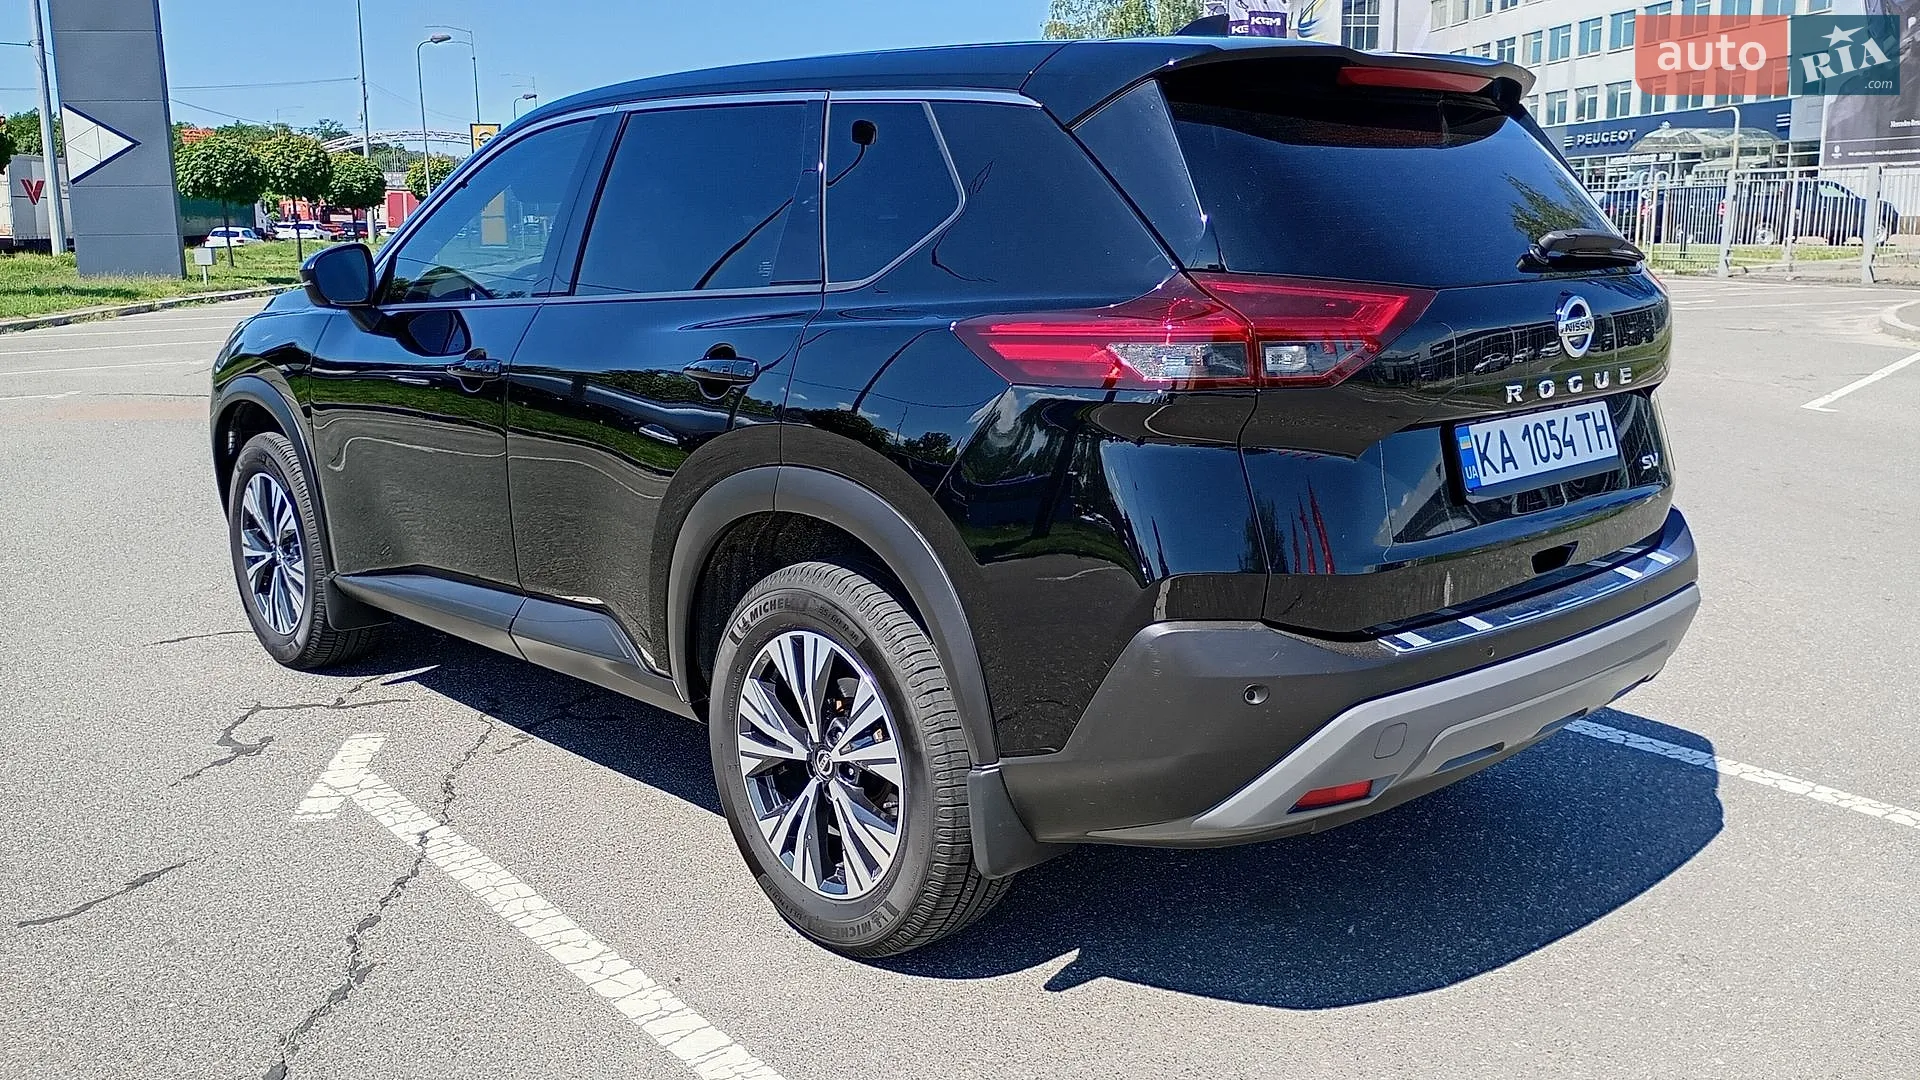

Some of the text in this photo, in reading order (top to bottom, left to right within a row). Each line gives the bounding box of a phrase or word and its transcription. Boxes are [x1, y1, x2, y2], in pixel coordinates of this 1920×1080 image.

[1231, 25, 1249, 34] KG
[1250, 17, 1281, 26] KGM
[1576, 129, 1637, 146] PEUGEOT
[1563, 318, 1595, 334] NISSAN
[1505, 367, 1632, 404] ROGUE
[1474, 409, 1613, 477] KA 1054 TH
[1641, 452, 1659, 470] SV
[1465, 465, 1479, 480] UA
[749, 598, 793, 621] MICHEL
